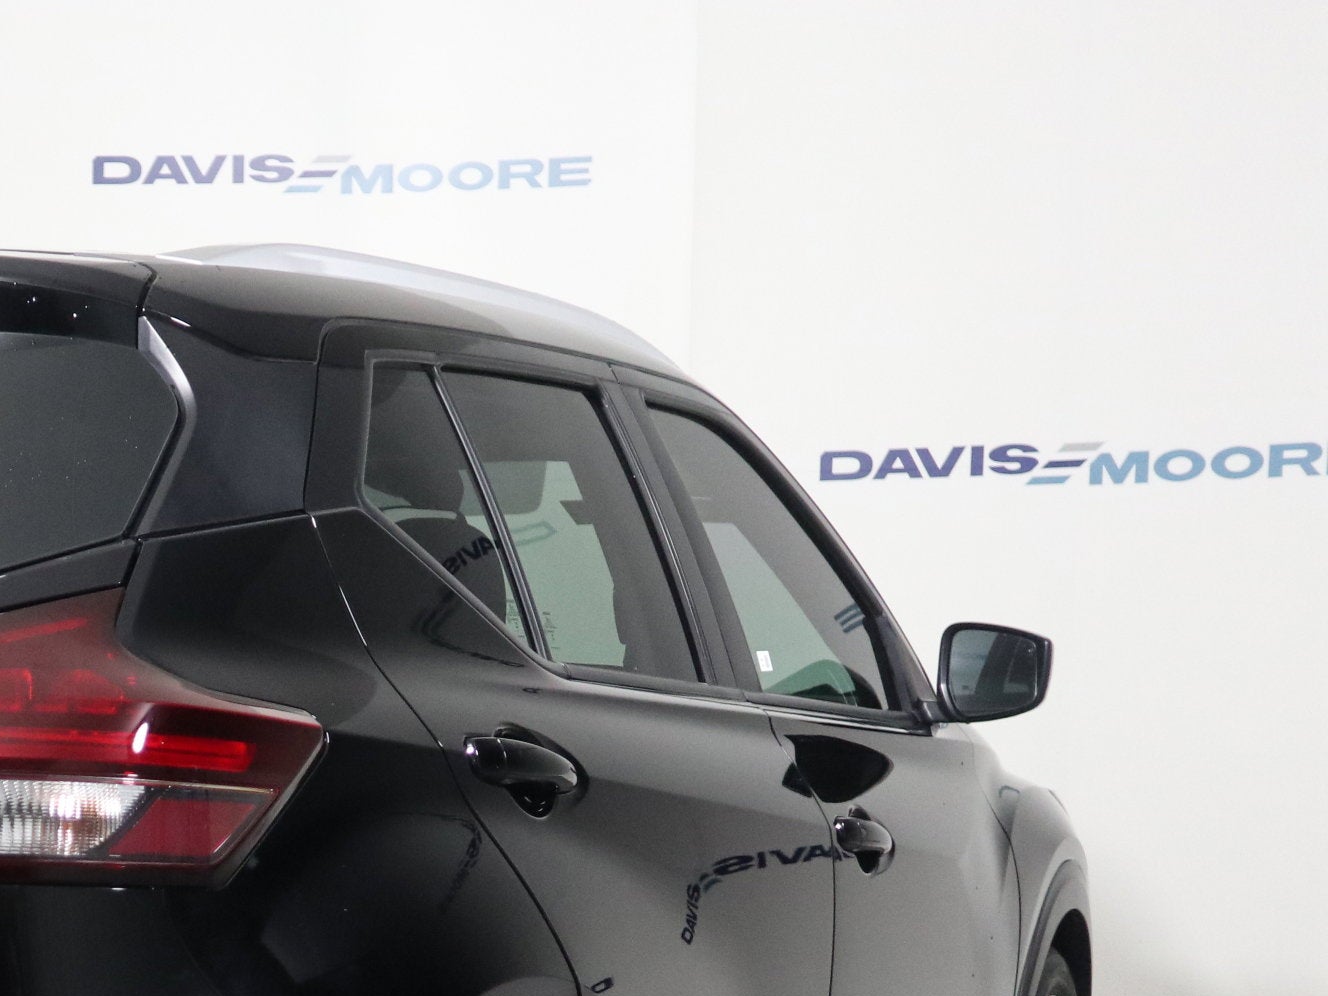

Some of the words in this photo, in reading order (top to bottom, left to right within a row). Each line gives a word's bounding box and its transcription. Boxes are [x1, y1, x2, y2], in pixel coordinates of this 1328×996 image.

[91, 154, 296, 186] DAVIS
[340, 156, 593, 195] MOORE
[819, 443, 1040, 482] DAVIS
[1088, 442, 1328, 485] MOOR
